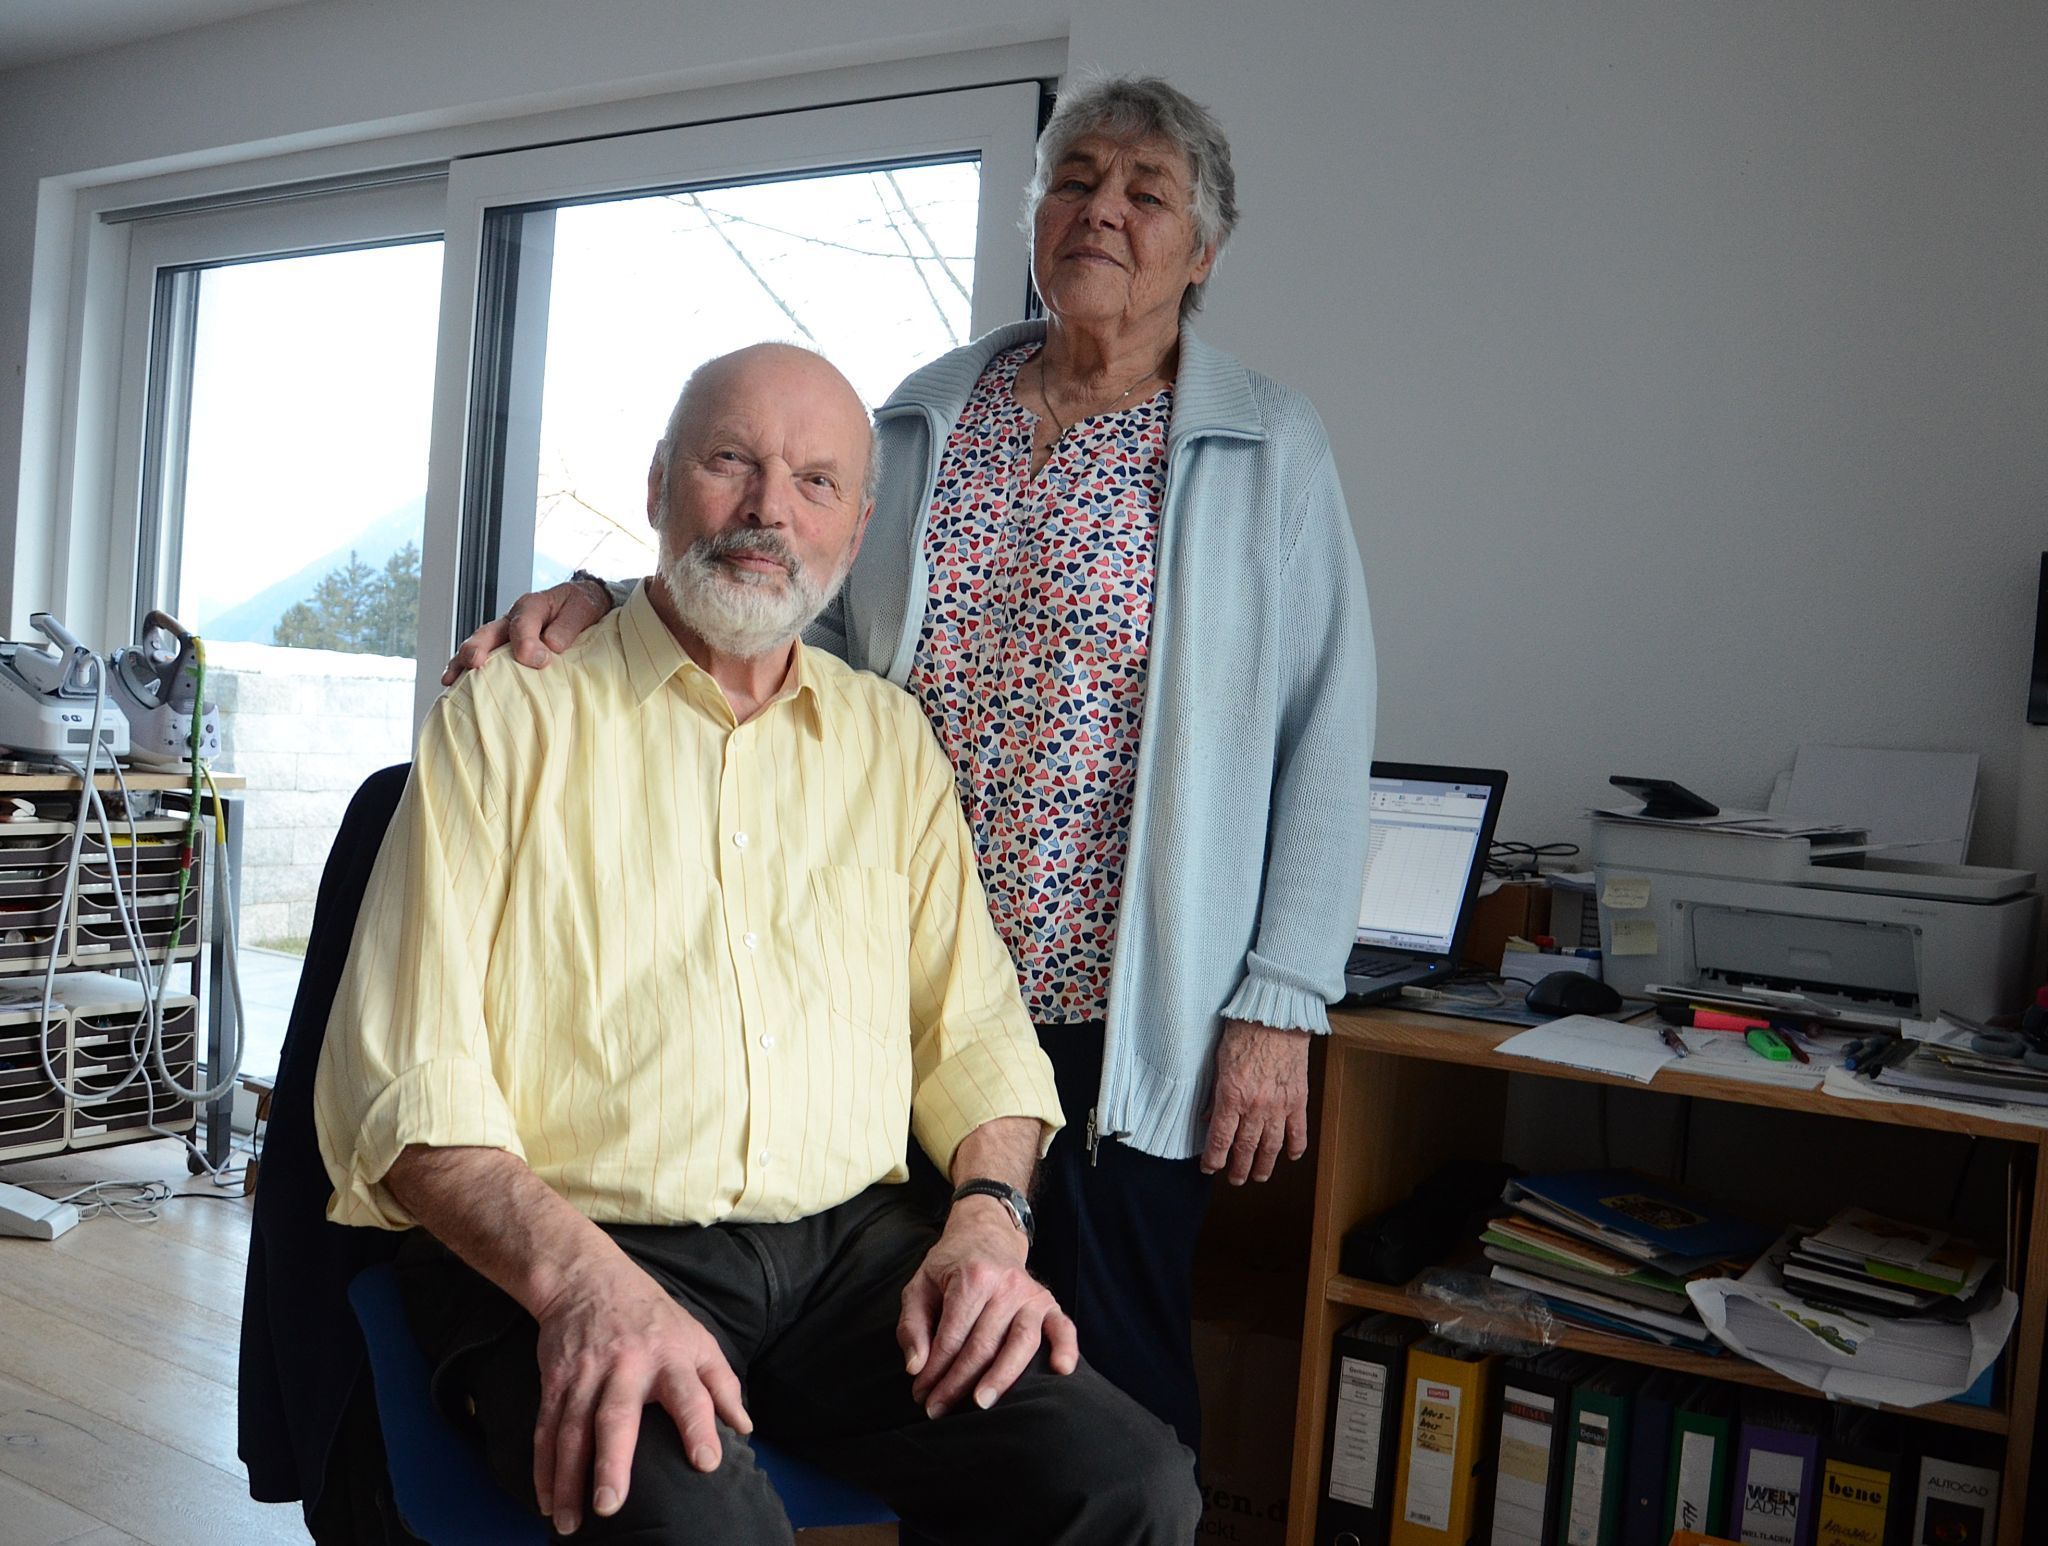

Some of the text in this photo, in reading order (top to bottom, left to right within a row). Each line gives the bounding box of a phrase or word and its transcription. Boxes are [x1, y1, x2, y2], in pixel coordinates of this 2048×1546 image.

[1748, 1484, 1799, 1506] WELT
[1829, 1475, 1882, 1504] bene
[1928, 1477, 1989, 1497] AUTOCAD
[1744, 1497, 1797, 1518] LADEN
[1742, 1529, 1792, 1544] WELTLADEN
